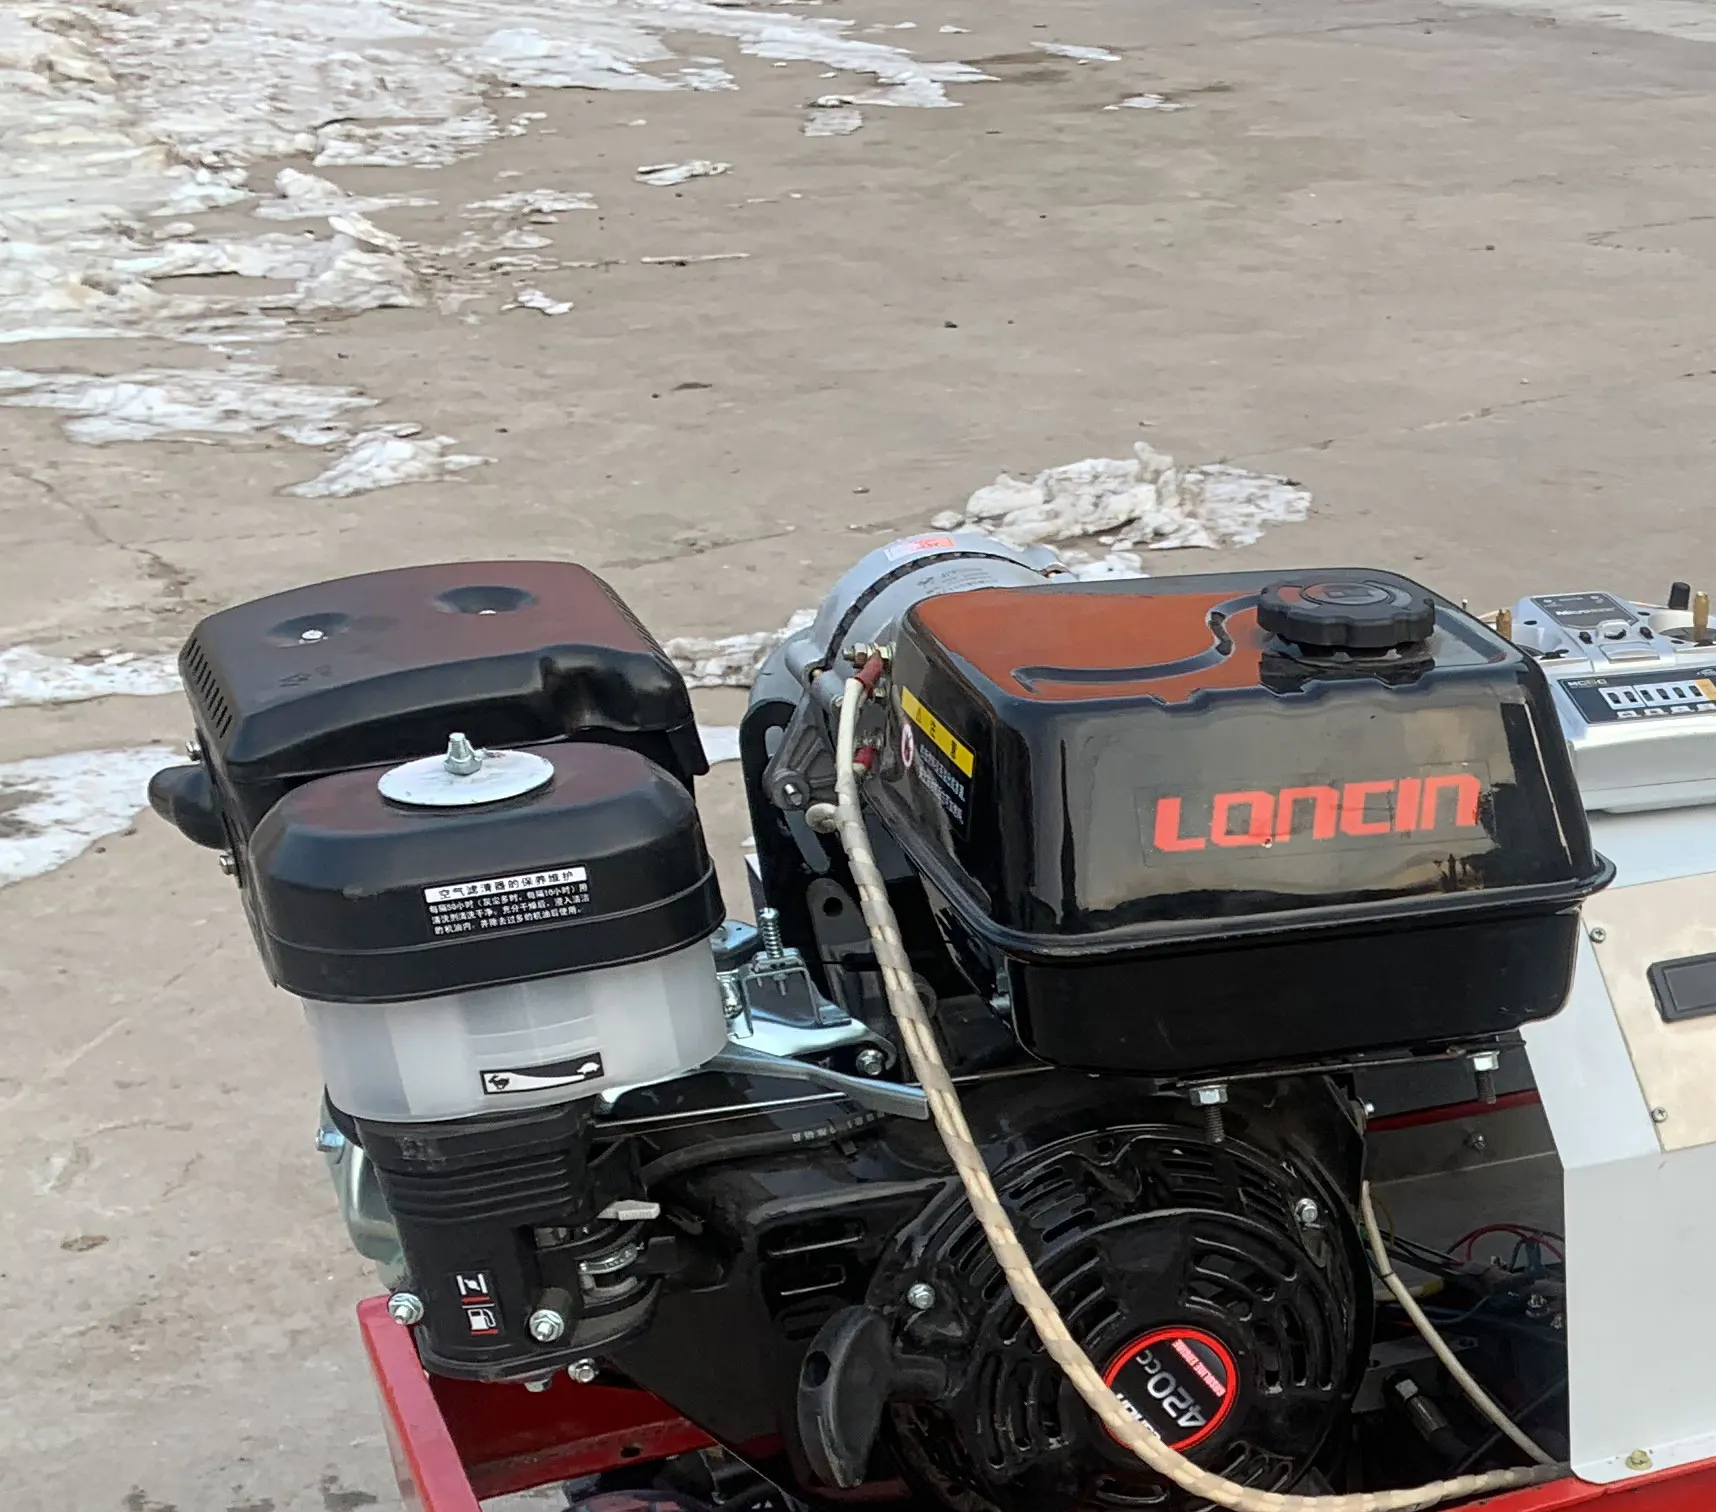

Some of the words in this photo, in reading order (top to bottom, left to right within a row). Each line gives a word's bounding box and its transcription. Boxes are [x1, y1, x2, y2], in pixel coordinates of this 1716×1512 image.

[1153, 773, 1482, 853] LONCIN
[438, 870, 573, 900] 空气滤清器的保养维护
[1171, 1338, 1200, 1367] ENGINE
[1135, 1350, 1208, 1428] 420cc
[1192, 1361, 1227, 1398] GASOLINE
